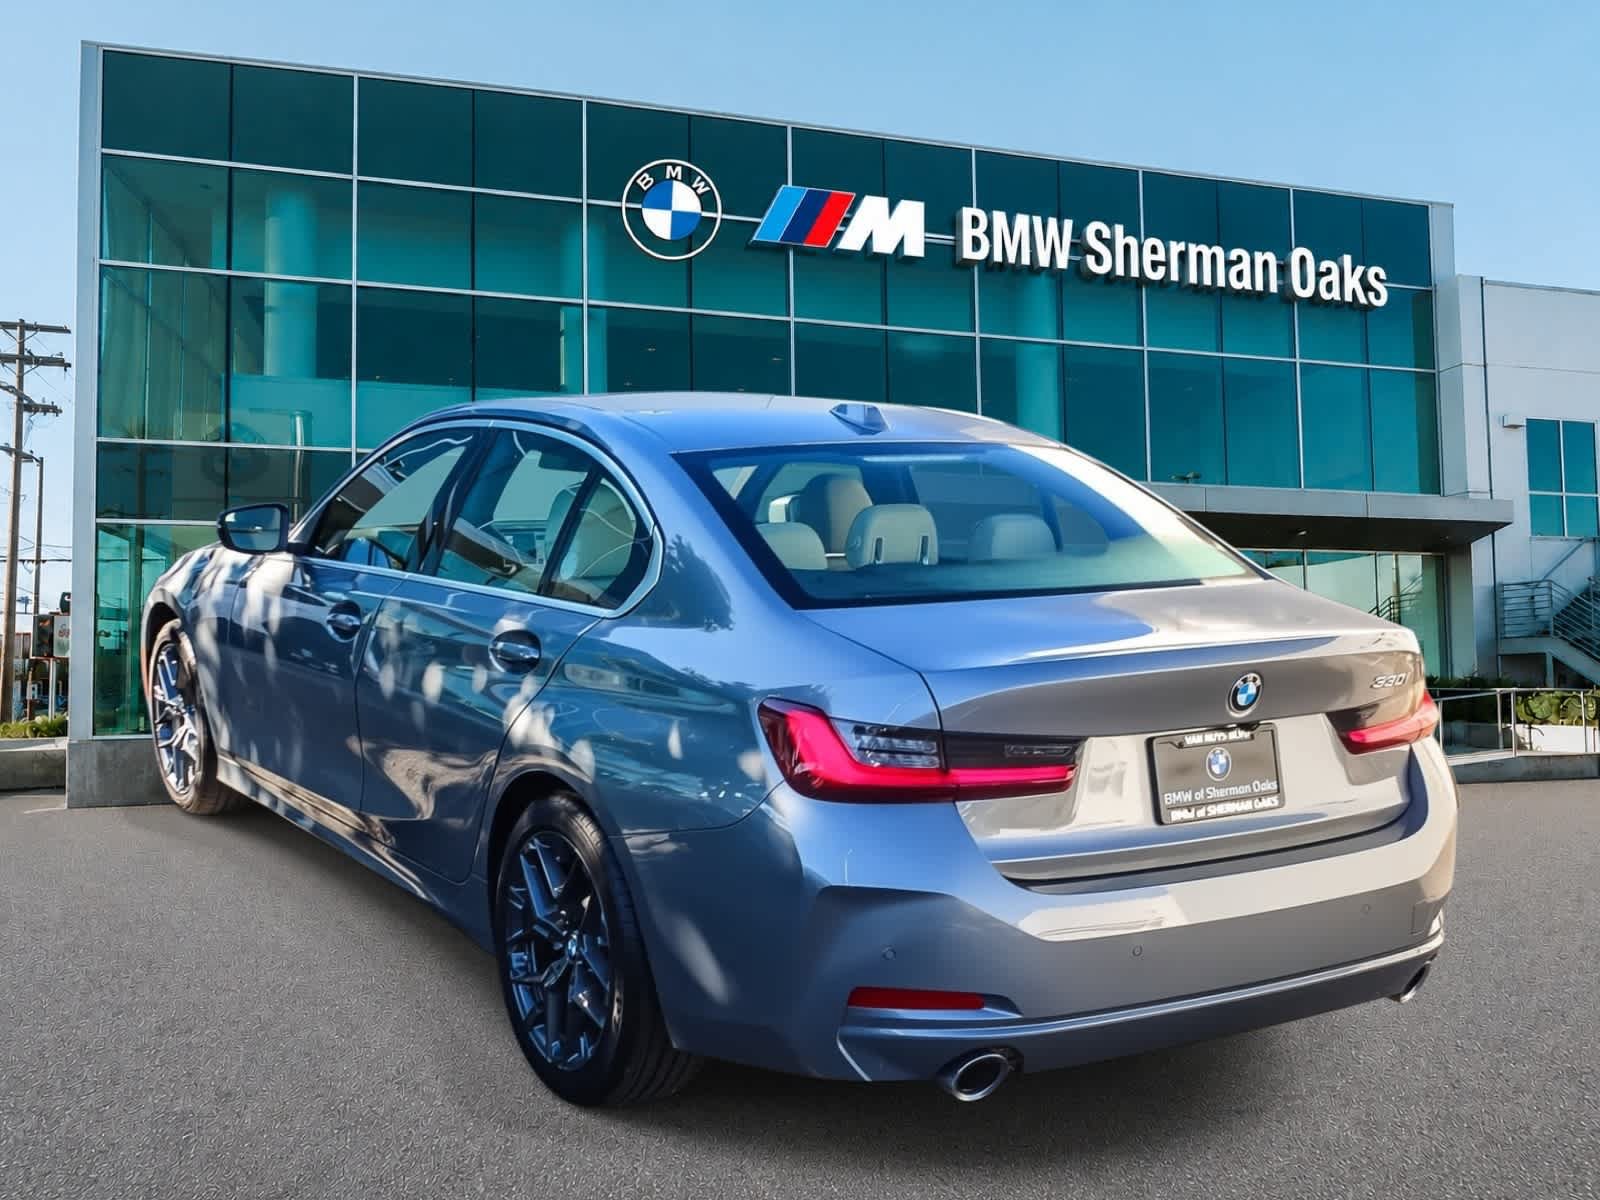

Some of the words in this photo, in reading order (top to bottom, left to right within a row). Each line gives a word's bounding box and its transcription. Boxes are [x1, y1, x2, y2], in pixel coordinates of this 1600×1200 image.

[636, 165, 711, 196] BMW
[959, 206, 1073, 269] BMW
[1084, 220, 1278, 293] Sherman
[1288, 247, 1388, 307] Oaks
[1164, 790, 1192, 805] BMW
[1194, 788, 1205, 801] of
[1206, 782, 1251, 799] Sherman
[1252, 780, 1277, 793] Oaks
